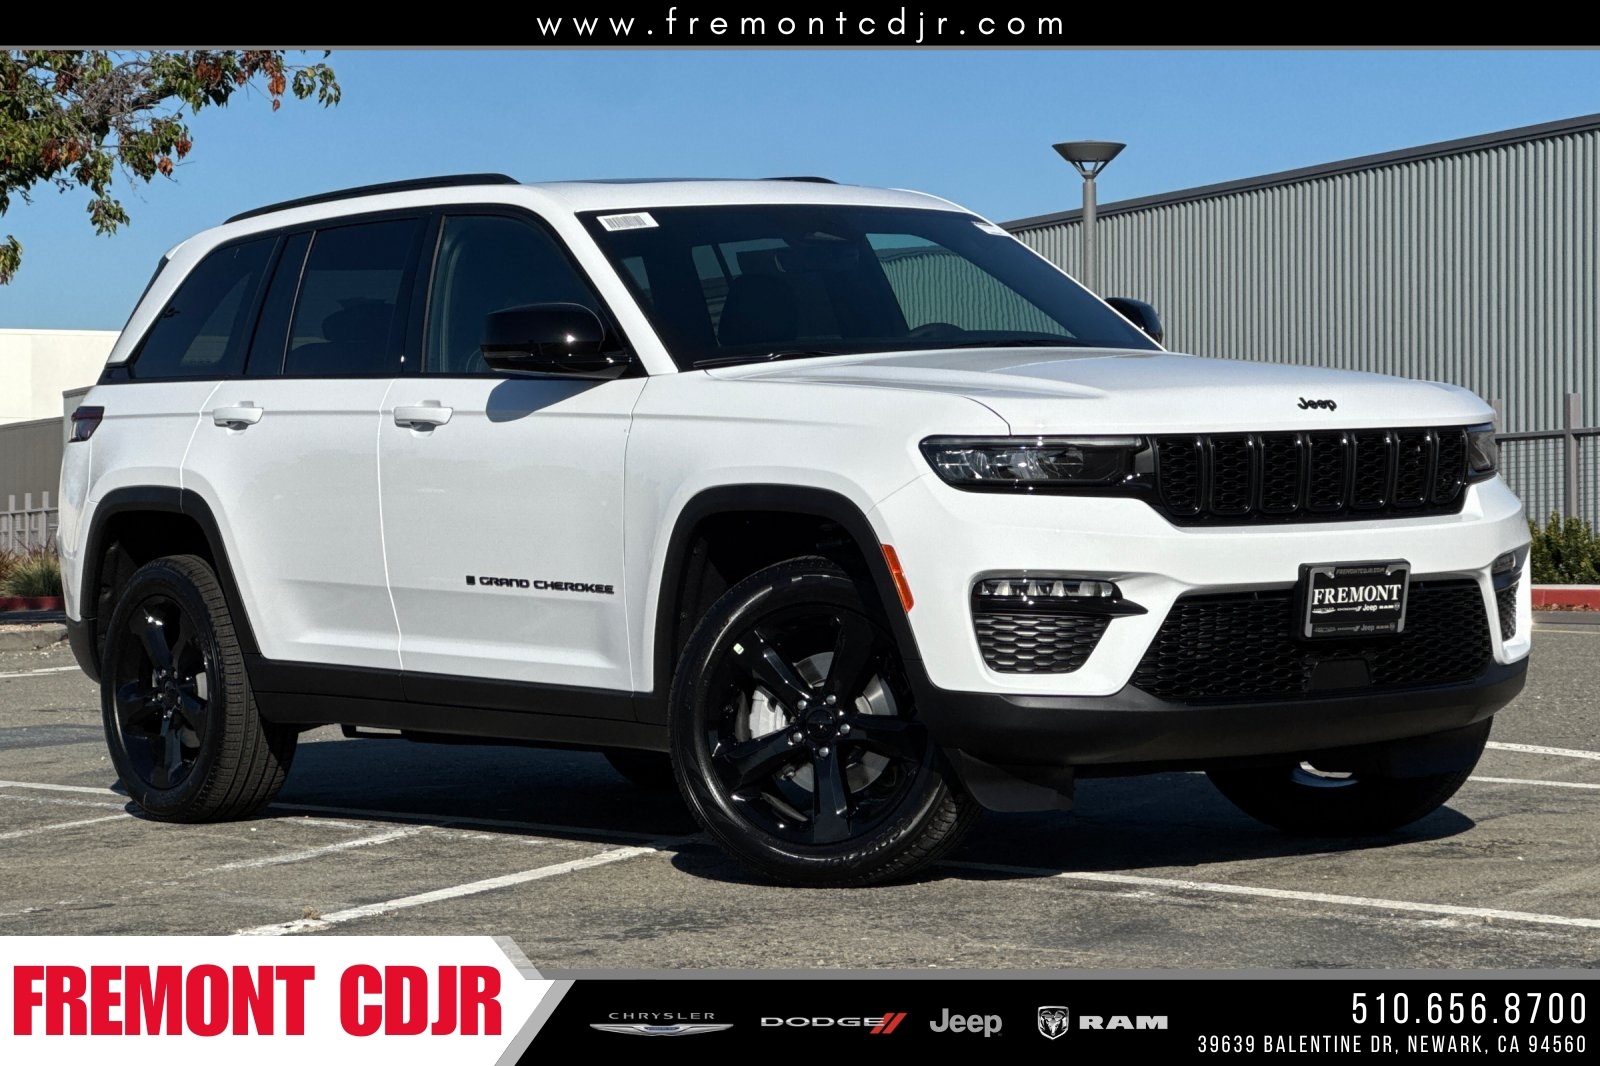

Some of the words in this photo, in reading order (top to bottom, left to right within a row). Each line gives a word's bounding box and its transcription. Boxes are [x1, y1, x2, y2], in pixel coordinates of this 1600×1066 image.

[1297, 396, 1337, 411] Jeep
[479, 576, 530, 589] GRAND
[533, 580, 614, 594] CHEROKEE
[1312, 584, 1401, 605] FREMONT
